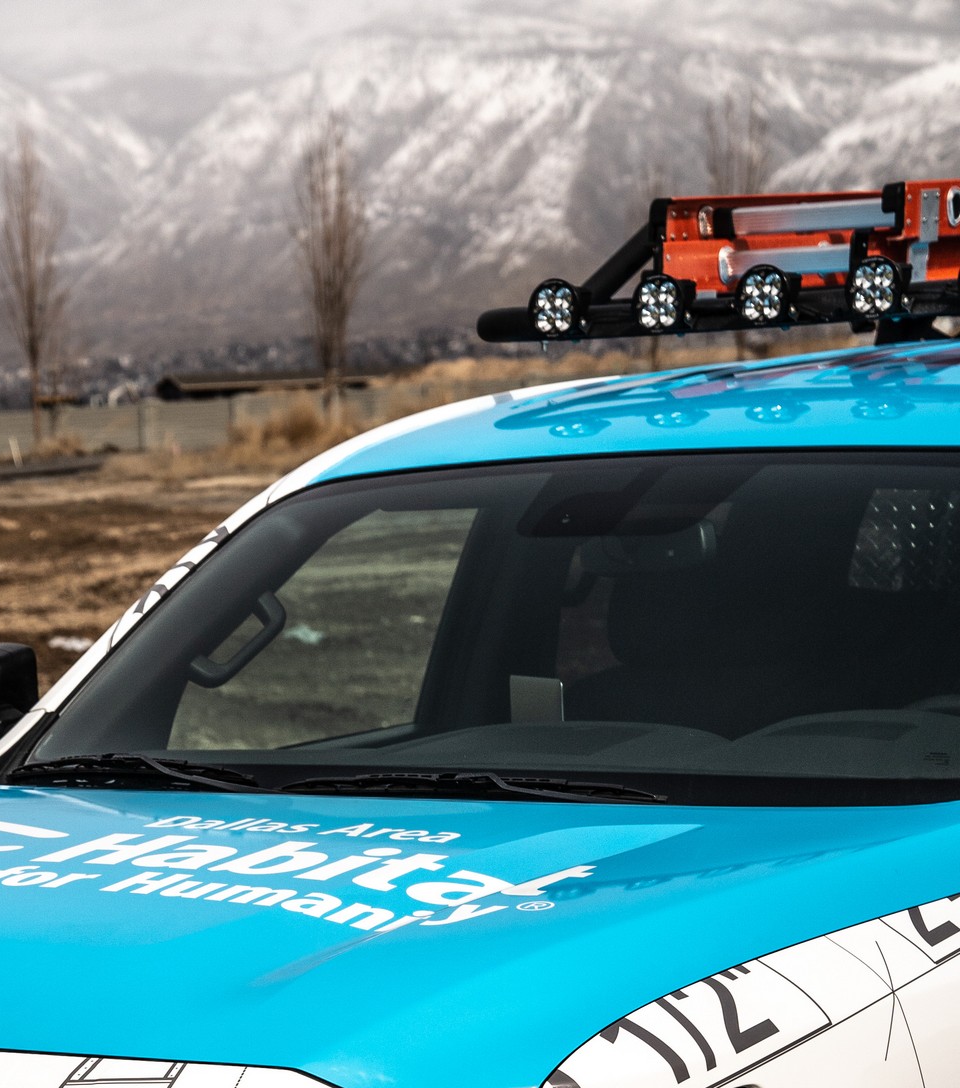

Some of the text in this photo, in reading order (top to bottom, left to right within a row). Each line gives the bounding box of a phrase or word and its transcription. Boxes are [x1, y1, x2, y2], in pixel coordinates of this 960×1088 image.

[143, 815, 463, 844] Dallas Area
[30, 832, 598, 907] Habitat
[99, 871, 510, 932] Humaniy
